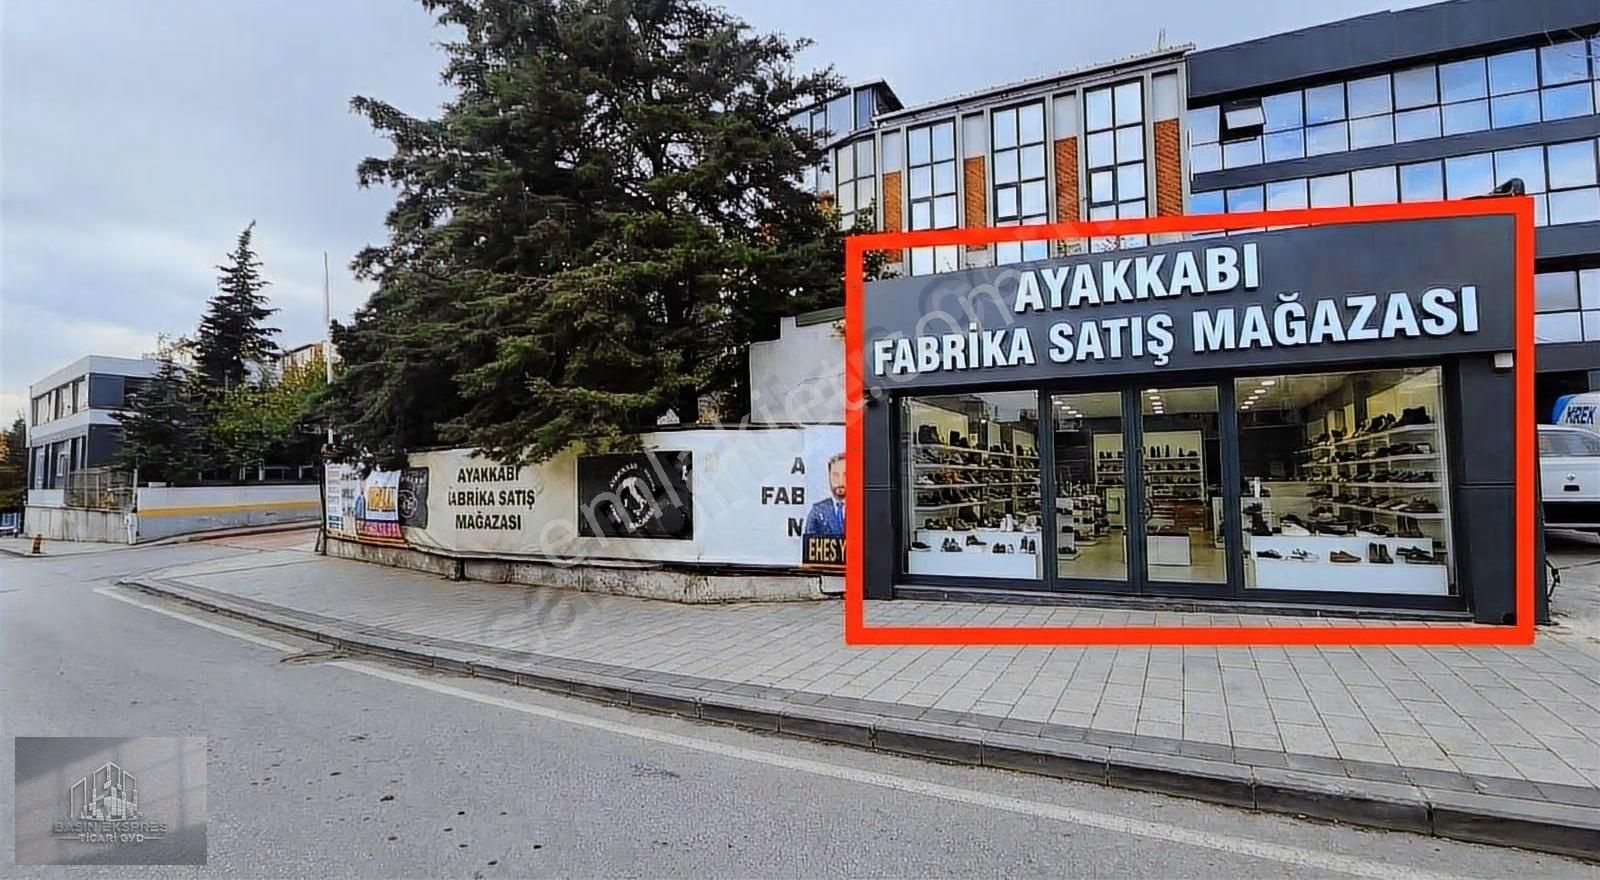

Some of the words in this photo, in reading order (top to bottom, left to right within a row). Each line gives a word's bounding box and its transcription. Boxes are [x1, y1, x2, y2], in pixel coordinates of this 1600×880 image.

[1013, 243, 1260, 313] AYAKKABI
[873, 322, 1036, 377] FABRİKA
[1048, 312, 1176, 367] SATIŞ
[1192, 285, 1481, 353] MAĞAZASI
[457, 465, 519, 483] AYAKKABI
[499, 488, 535, 510] SATIŞ
[455, 511, 521, 530] MAĞAZASI
